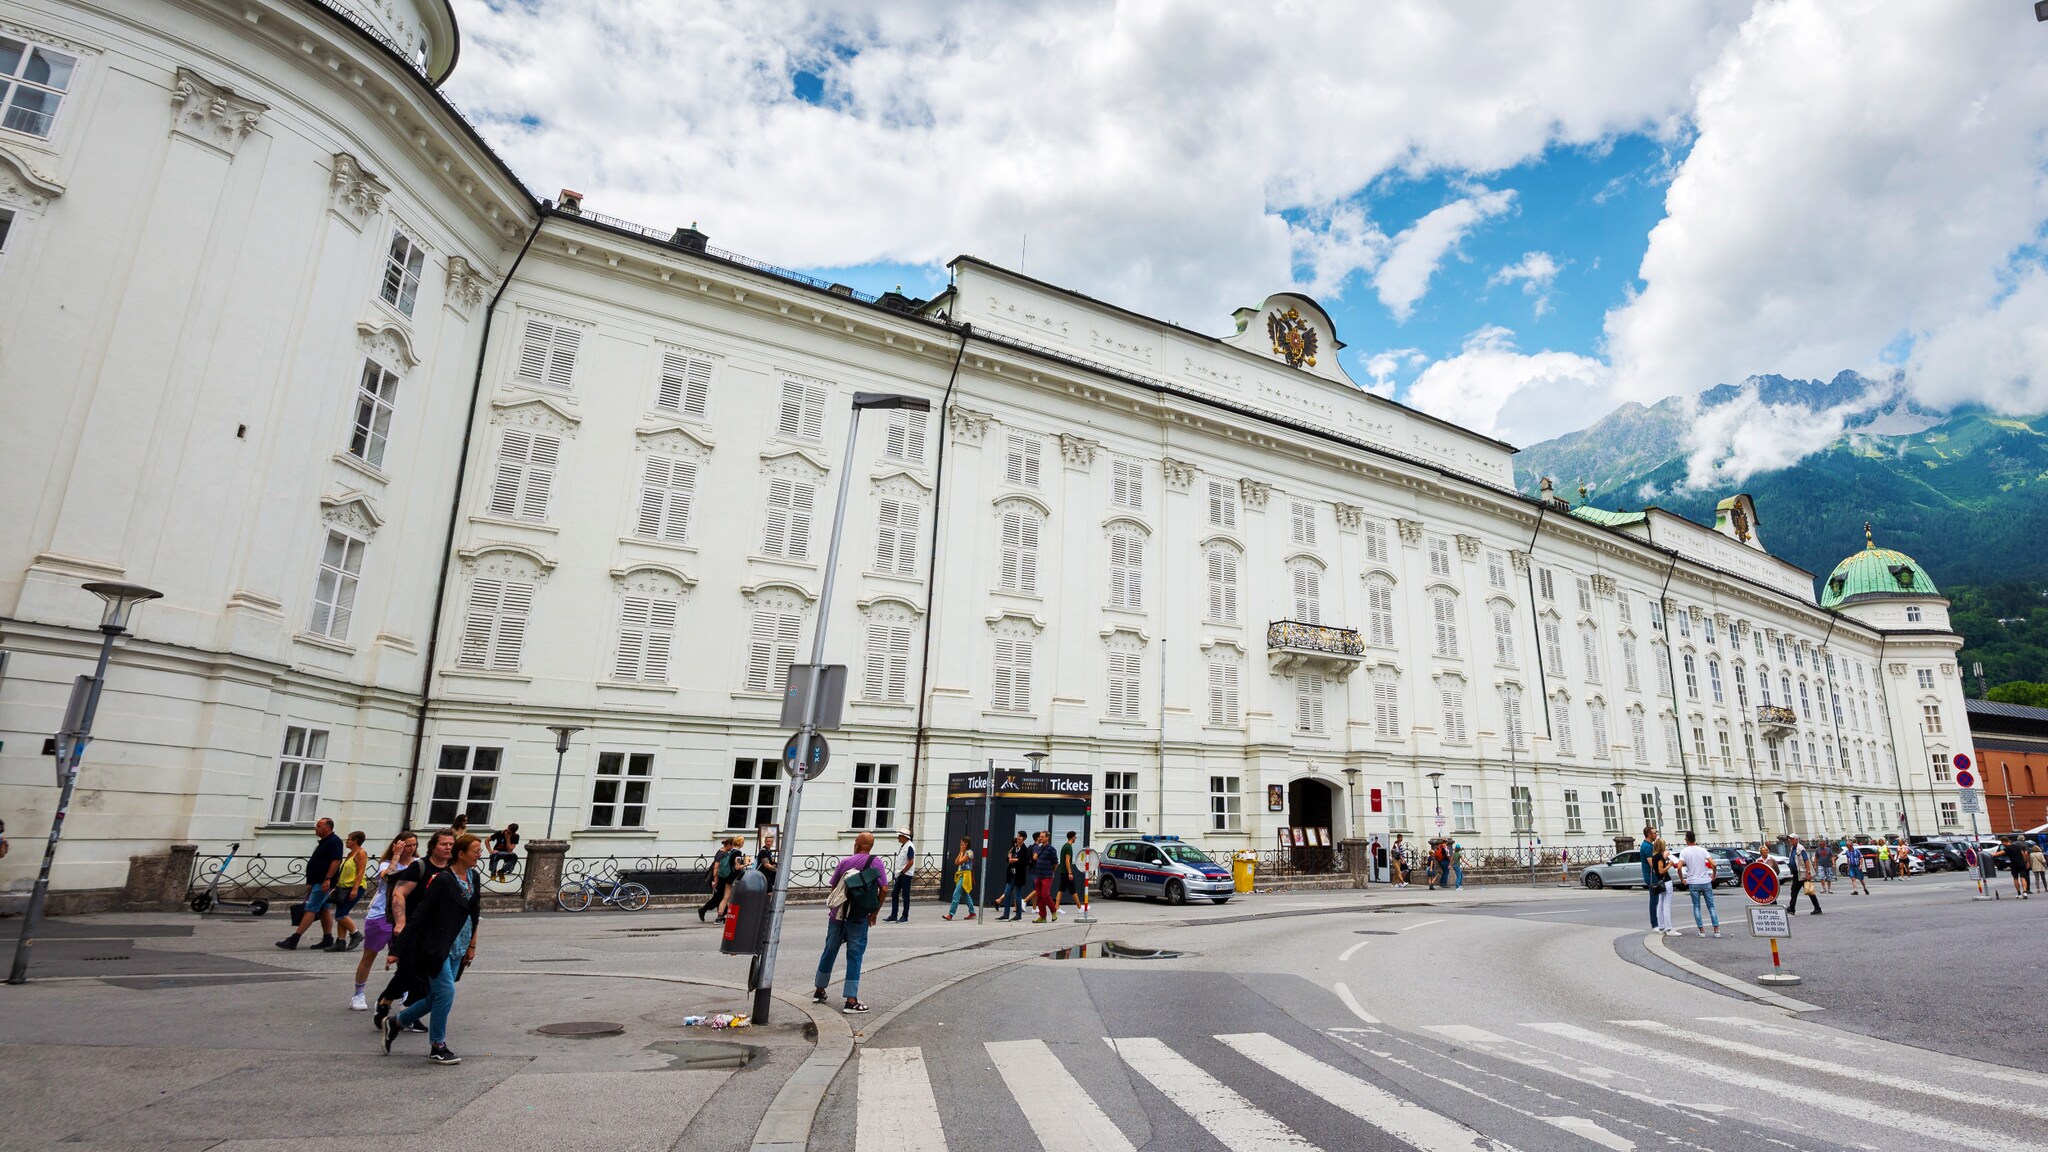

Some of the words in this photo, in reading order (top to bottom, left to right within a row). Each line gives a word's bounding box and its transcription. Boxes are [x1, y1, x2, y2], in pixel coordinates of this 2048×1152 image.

[968, 776, 994, 789] Tickes
[1050, 778, 1089, 791] Tickets
[1124, 873, 1147, 882] POLIZEI
[1752, 895, 1774, 903] ANFANG
